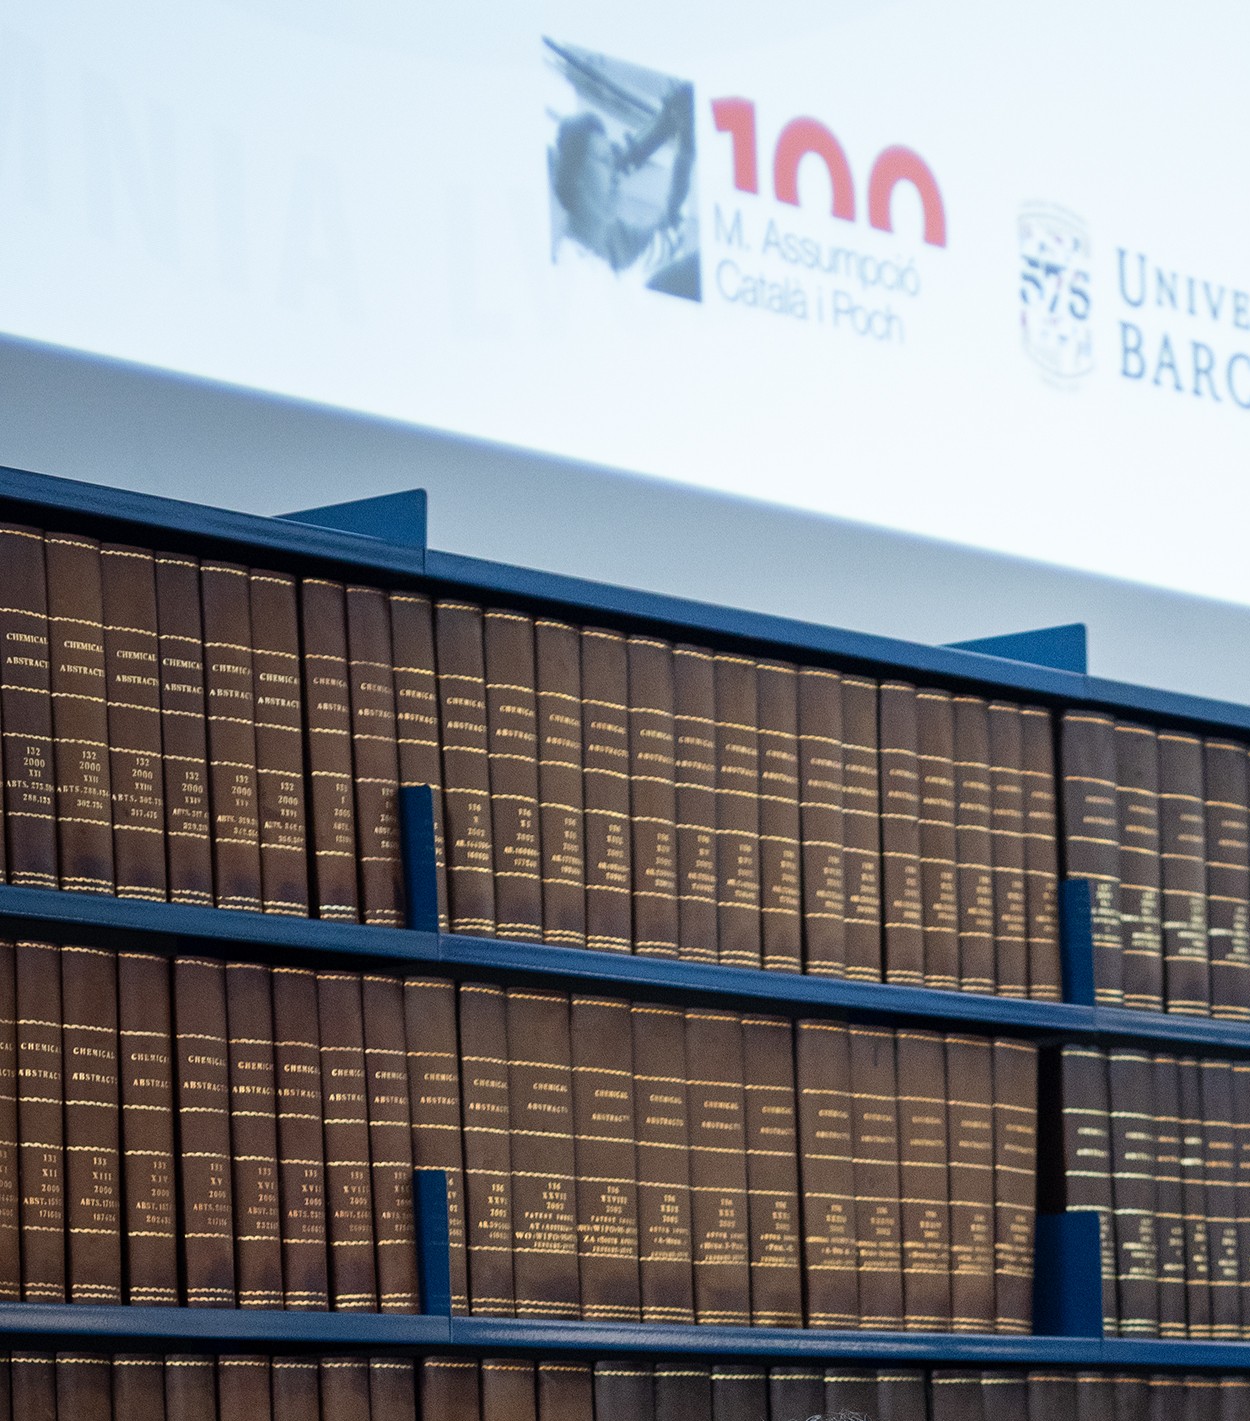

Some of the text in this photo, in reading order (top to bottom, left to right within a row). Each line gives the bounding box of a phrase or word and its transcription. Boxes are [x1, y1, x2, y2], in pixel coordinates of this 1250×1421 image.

[714, 203, 921, 298] M. Assumpció
[716, 258, 905, 341] Català i Poch
[6, 632, 48, 646] CHEMICAL
[63, 640, 103, 653] CHEMICAL
[116, 650, 157, 662] CHEMICAL
[26, 746, 41, 756] 132
[82, 751, 96, 760] 132
[24, 757, 46, 768] 2000
[80, 761, 101, 772] 2000
[136, 757, 150, 767] 132
[132, 769, 153, 779] 2000
[185, 771, 200, 781] 132
[182, 783, 204, 794] 2000
[232, 786, 253, 797] 2000
[278, 795, 299, 806] 2000
[72, 1047, 115, 1060] CHEMICAL
[93, 1171, 112, 1181] XIII
[41, 1184, 60, 1193] 2000
[94, 1185, 113, 1194] 2000
[152, 1189, 170, 1197] 2000
